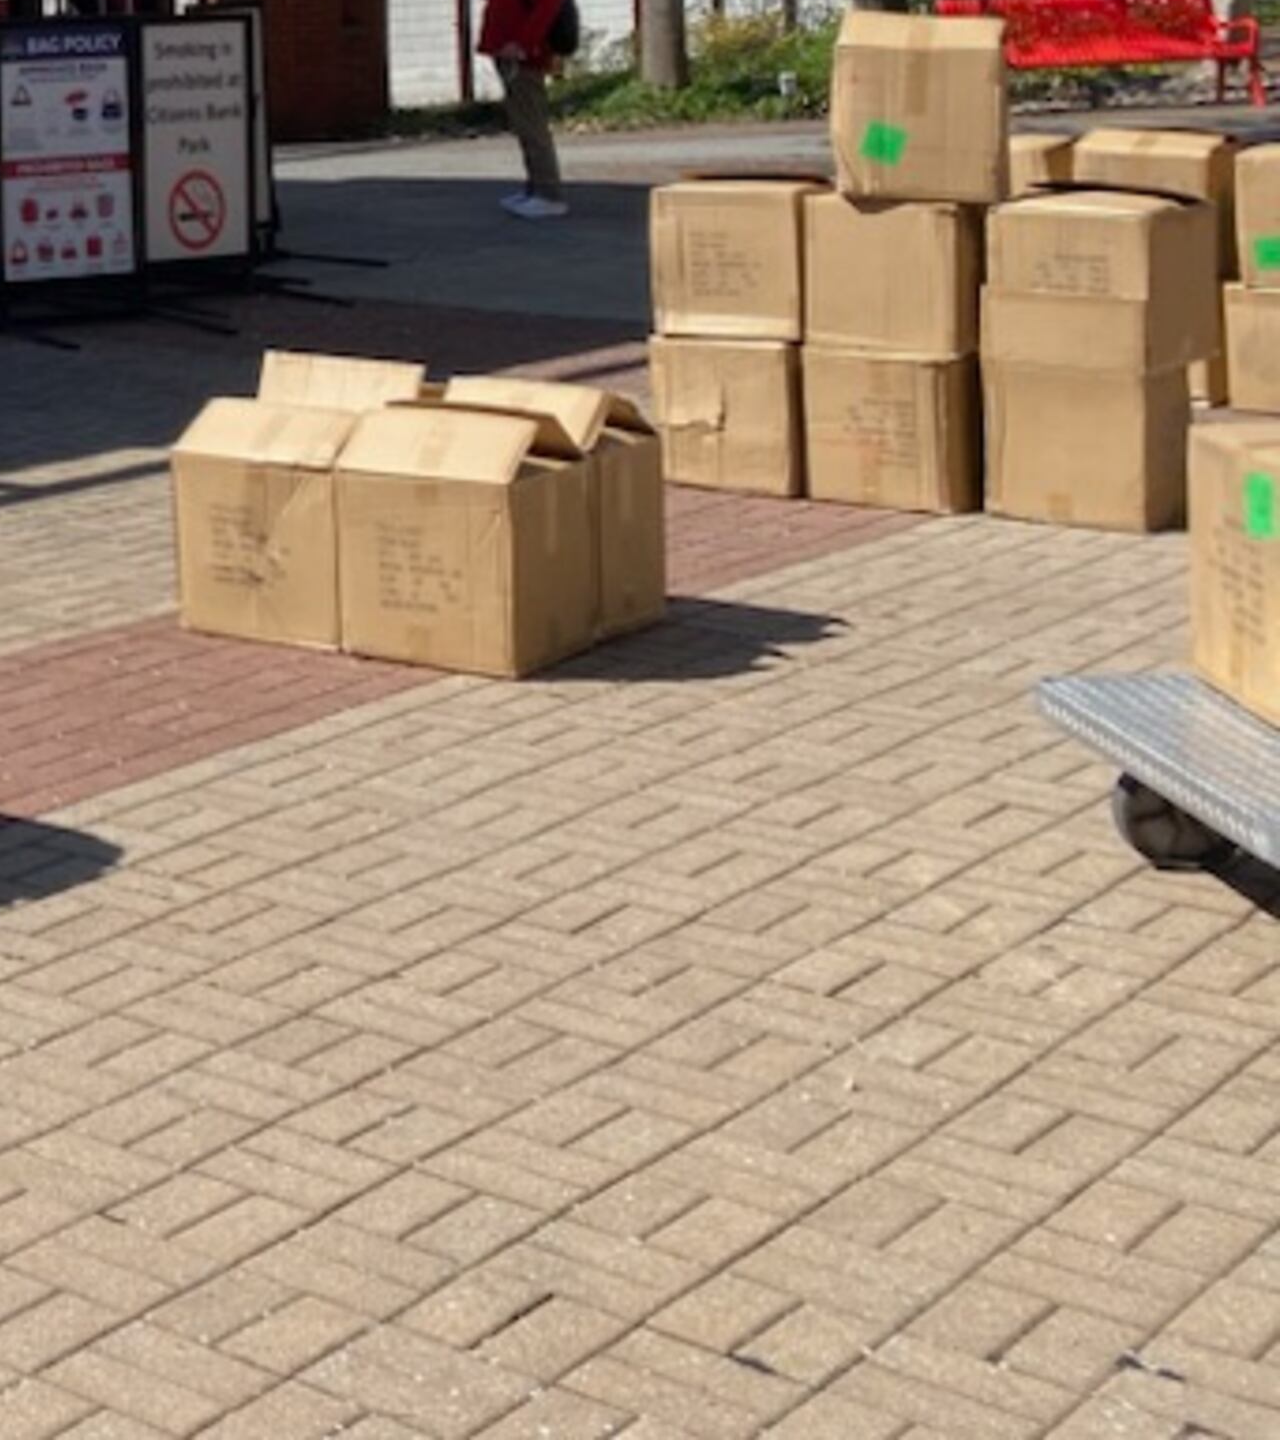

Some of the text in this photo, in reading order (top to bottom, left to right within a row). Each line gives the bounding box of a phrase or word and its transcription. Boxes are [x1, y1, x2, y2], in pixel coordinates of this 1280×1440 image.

[26, 32, 122, 53] BAG POLICY
[154, 41, 217, 60] Smoking
[146, 69, 223, 93] prohibited
[146, 101, 241, 123] Citizens Bank
[177, 135, 211, 154] Park
